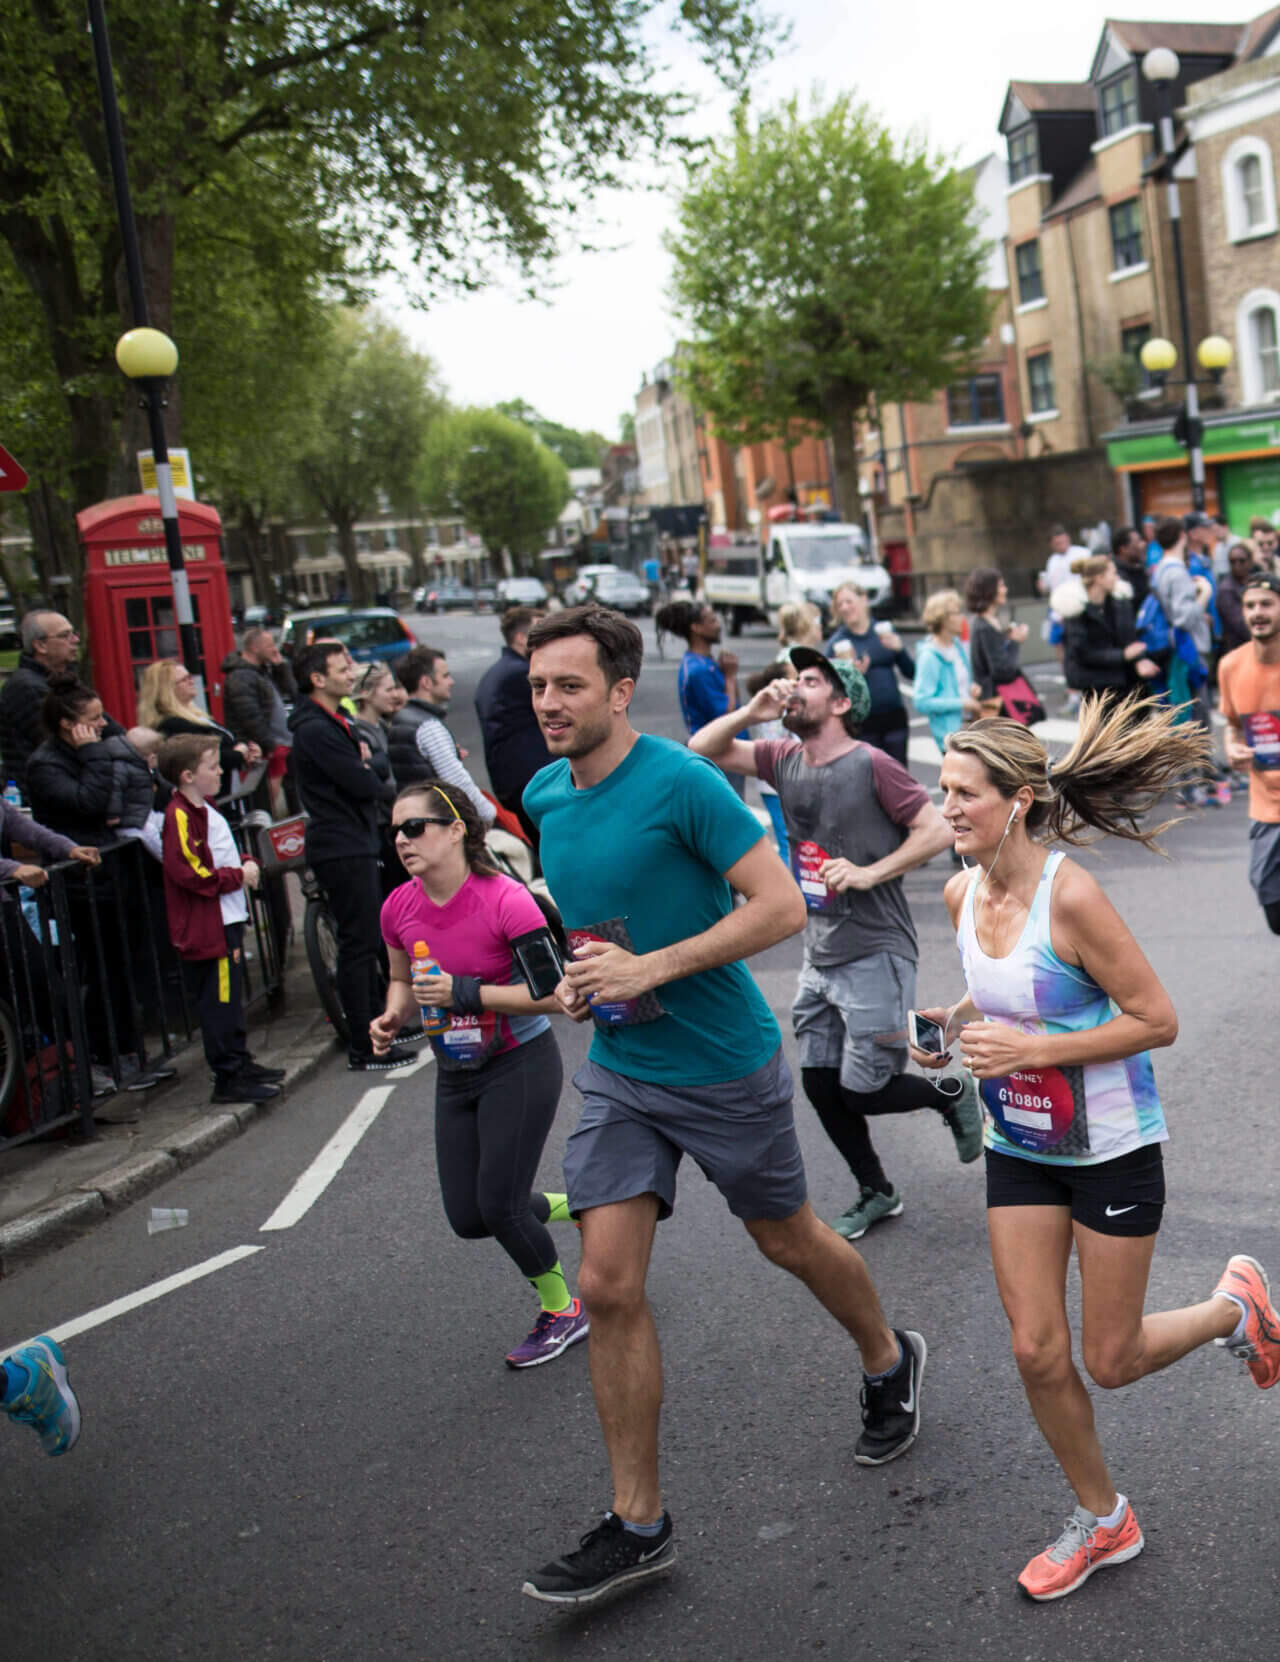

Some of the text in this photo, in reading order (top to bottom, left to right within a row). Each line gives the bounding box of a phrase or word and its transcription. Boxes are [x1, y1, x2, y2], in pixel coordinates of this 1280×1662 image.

[107, 544, 204, 566] TELPHNE
[1010, 1071, 1043, 1084] CKNEY
[998, 1087, 1053, 1110] G10806
